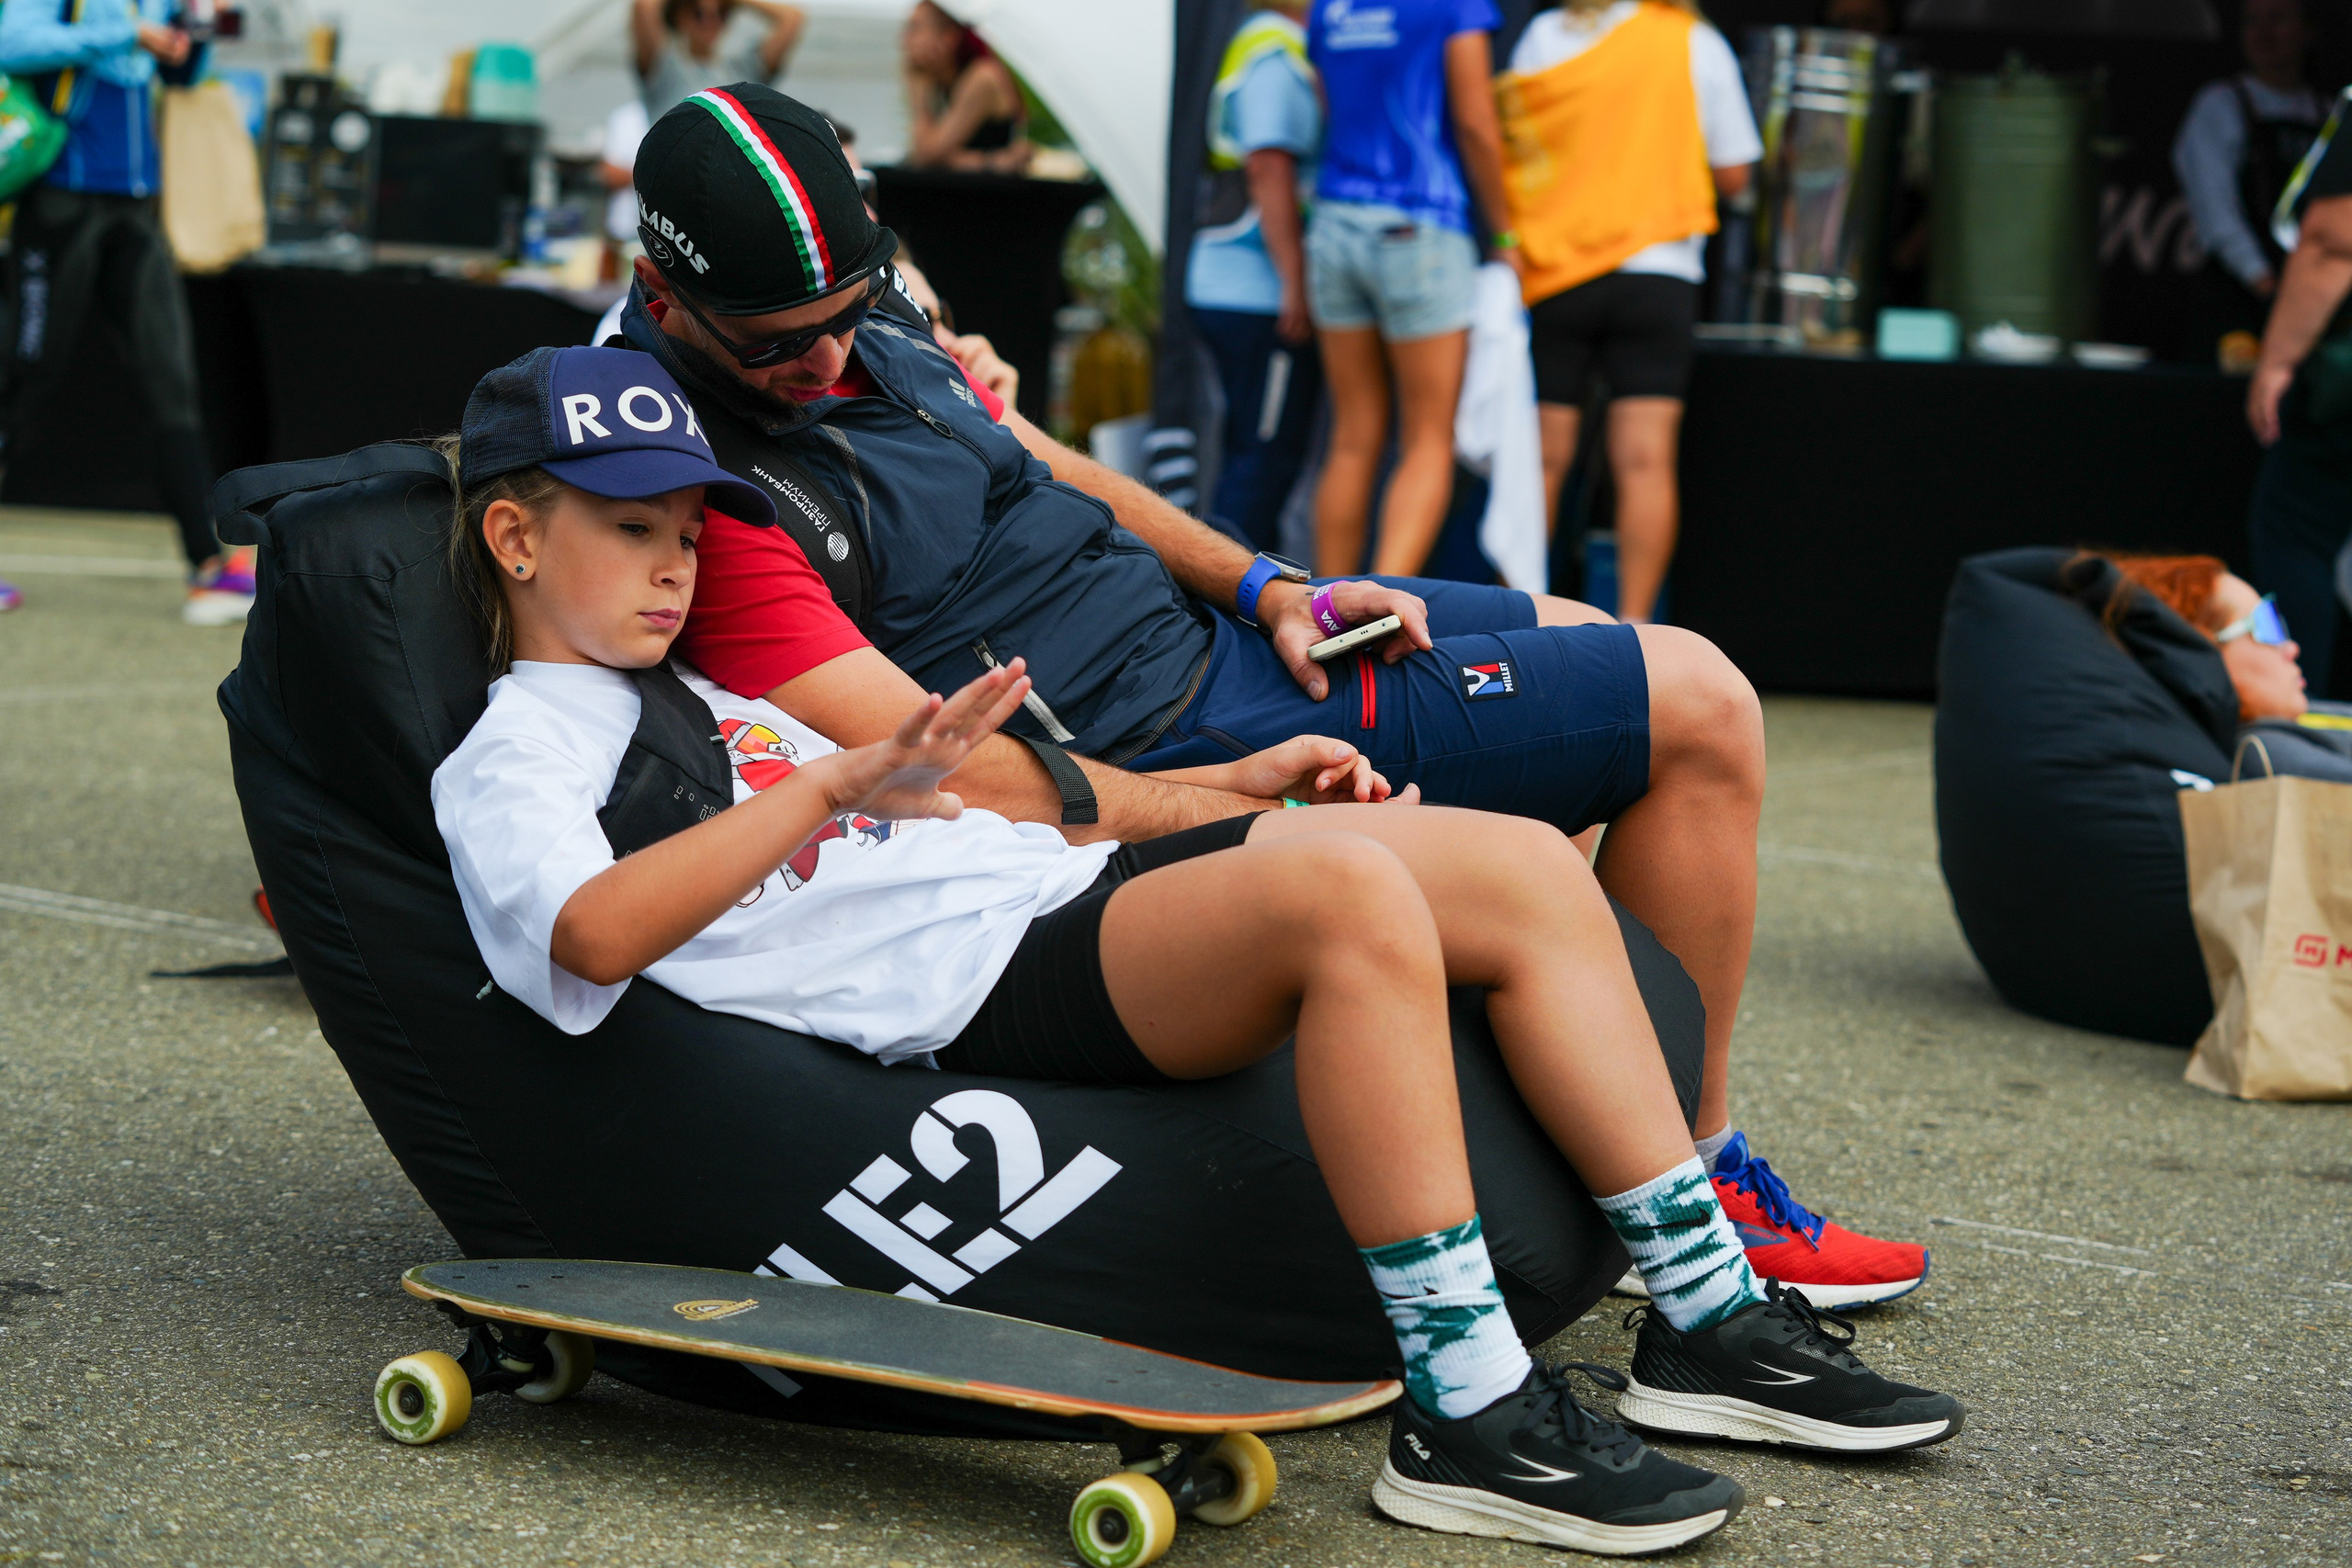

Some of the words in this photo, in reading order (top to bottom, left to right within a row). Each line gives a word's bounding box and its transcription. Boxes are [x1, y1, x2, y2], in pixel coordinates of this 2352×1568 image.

[751, 465, 826, 533] ГАЗПРОМБАНК
[783, 479, 831, 526] ПРЕМИУМ
[1498, 661, 1514, 693] MILLET
[1743, 1226, 1778, 1241] BROOKS
[1404, 1432, 1431, 1461] FILA
